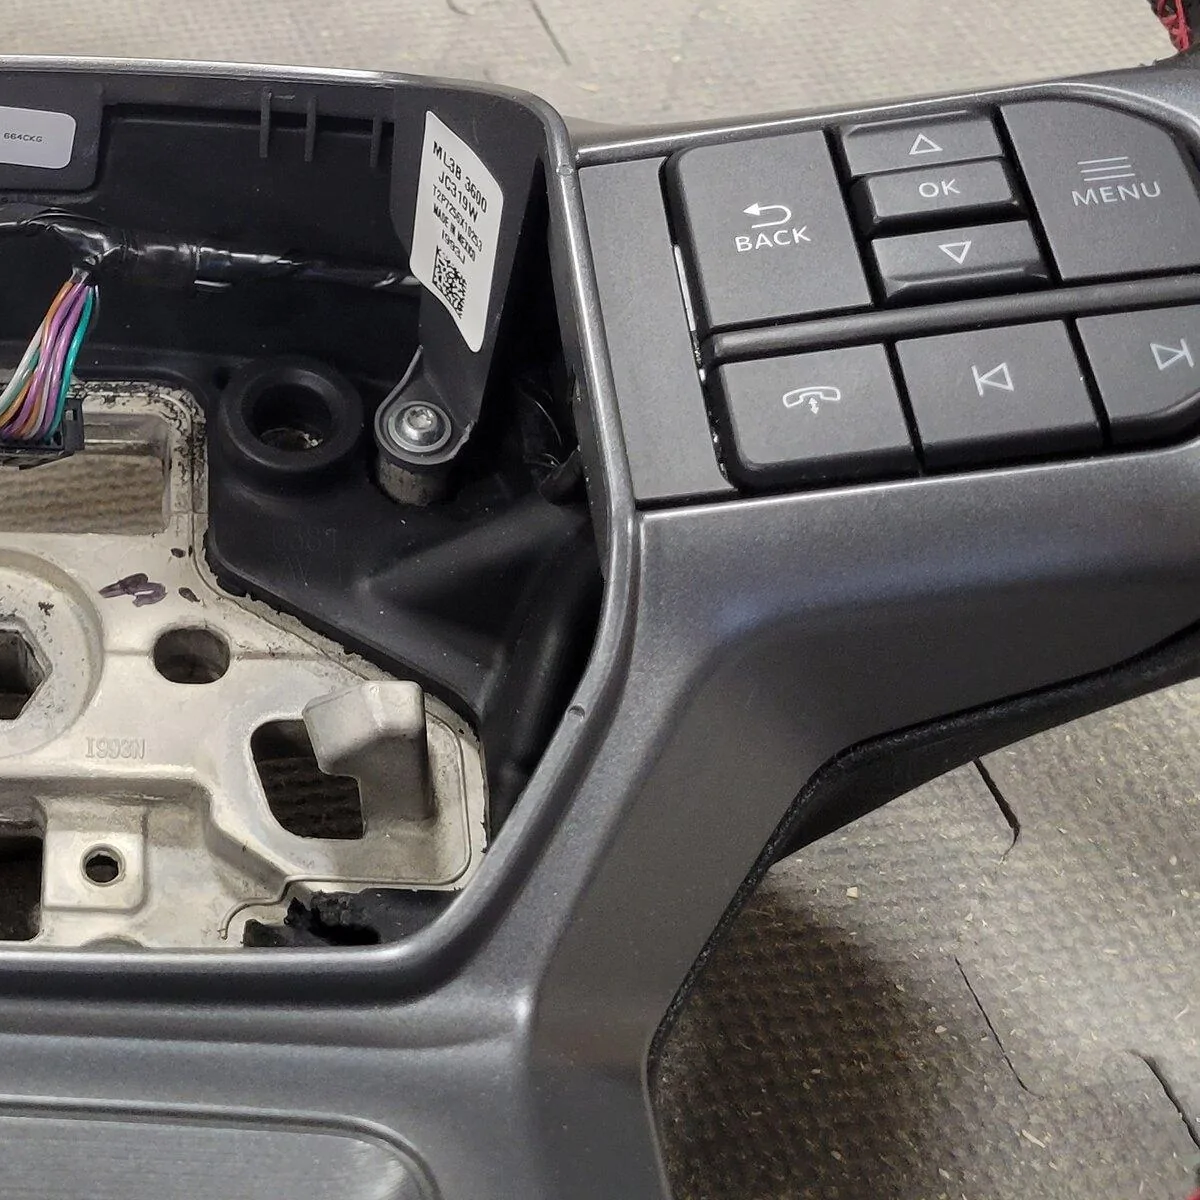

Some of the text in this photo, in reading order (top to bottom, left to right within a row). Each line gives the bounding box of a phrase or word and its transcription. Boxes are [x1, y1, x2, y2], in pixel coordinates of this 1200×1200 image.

[433, 141, 487, 213] ML3B 3600
[918, 179, 961, 198] OK
[1071, 181, 1162, 207] MENU
[438, 171, 479, 223] JC319W
[432, 202, 449, 229] MADE
[457, 231, 476, 262] MEXICO
[735, 226, 811, 253] BACK
